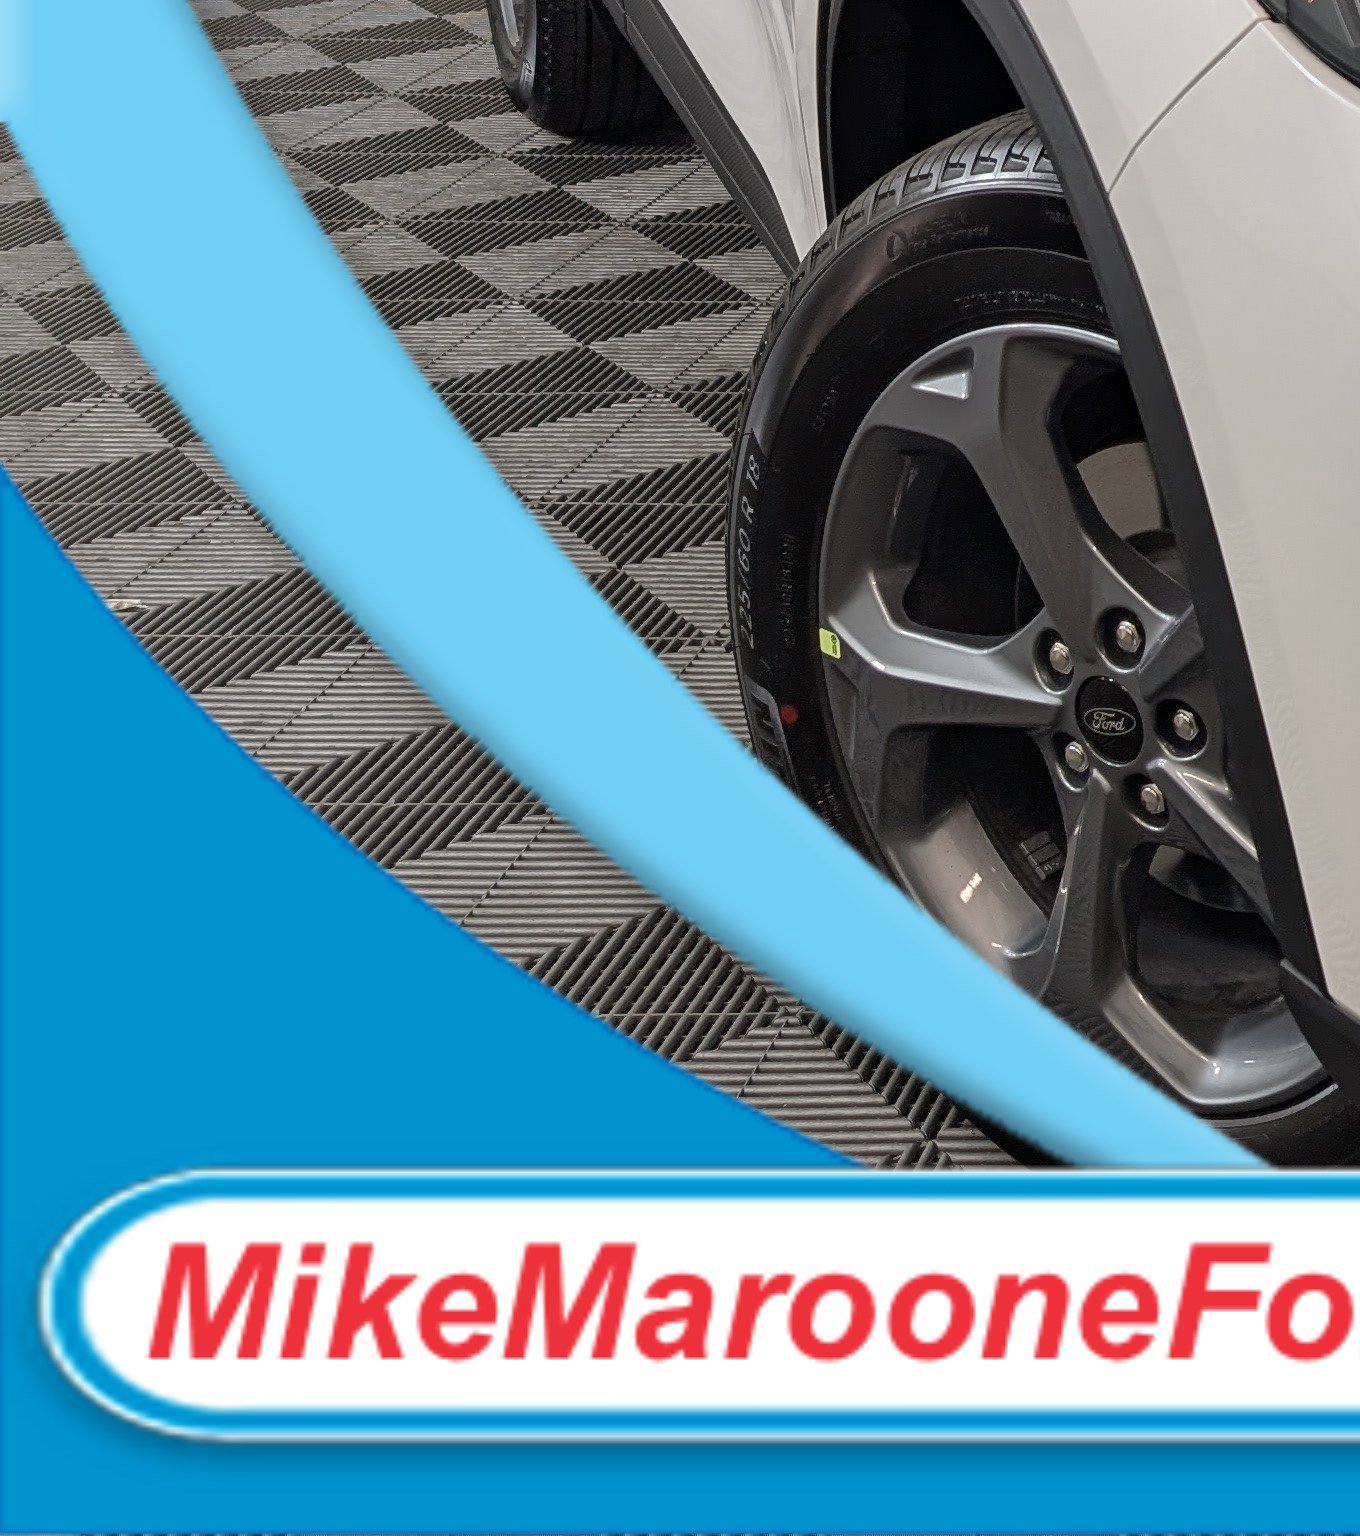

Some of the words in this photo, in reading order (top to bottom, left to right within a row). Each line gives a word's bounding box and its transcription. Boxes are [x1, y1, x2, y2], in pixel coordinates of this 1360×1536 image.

[746, 454, 760, 490] 18
[741, 495, 754, 524] R
[737, 528, 755, 650] 225/60
[1092, 710, 1126, 731] Ford
